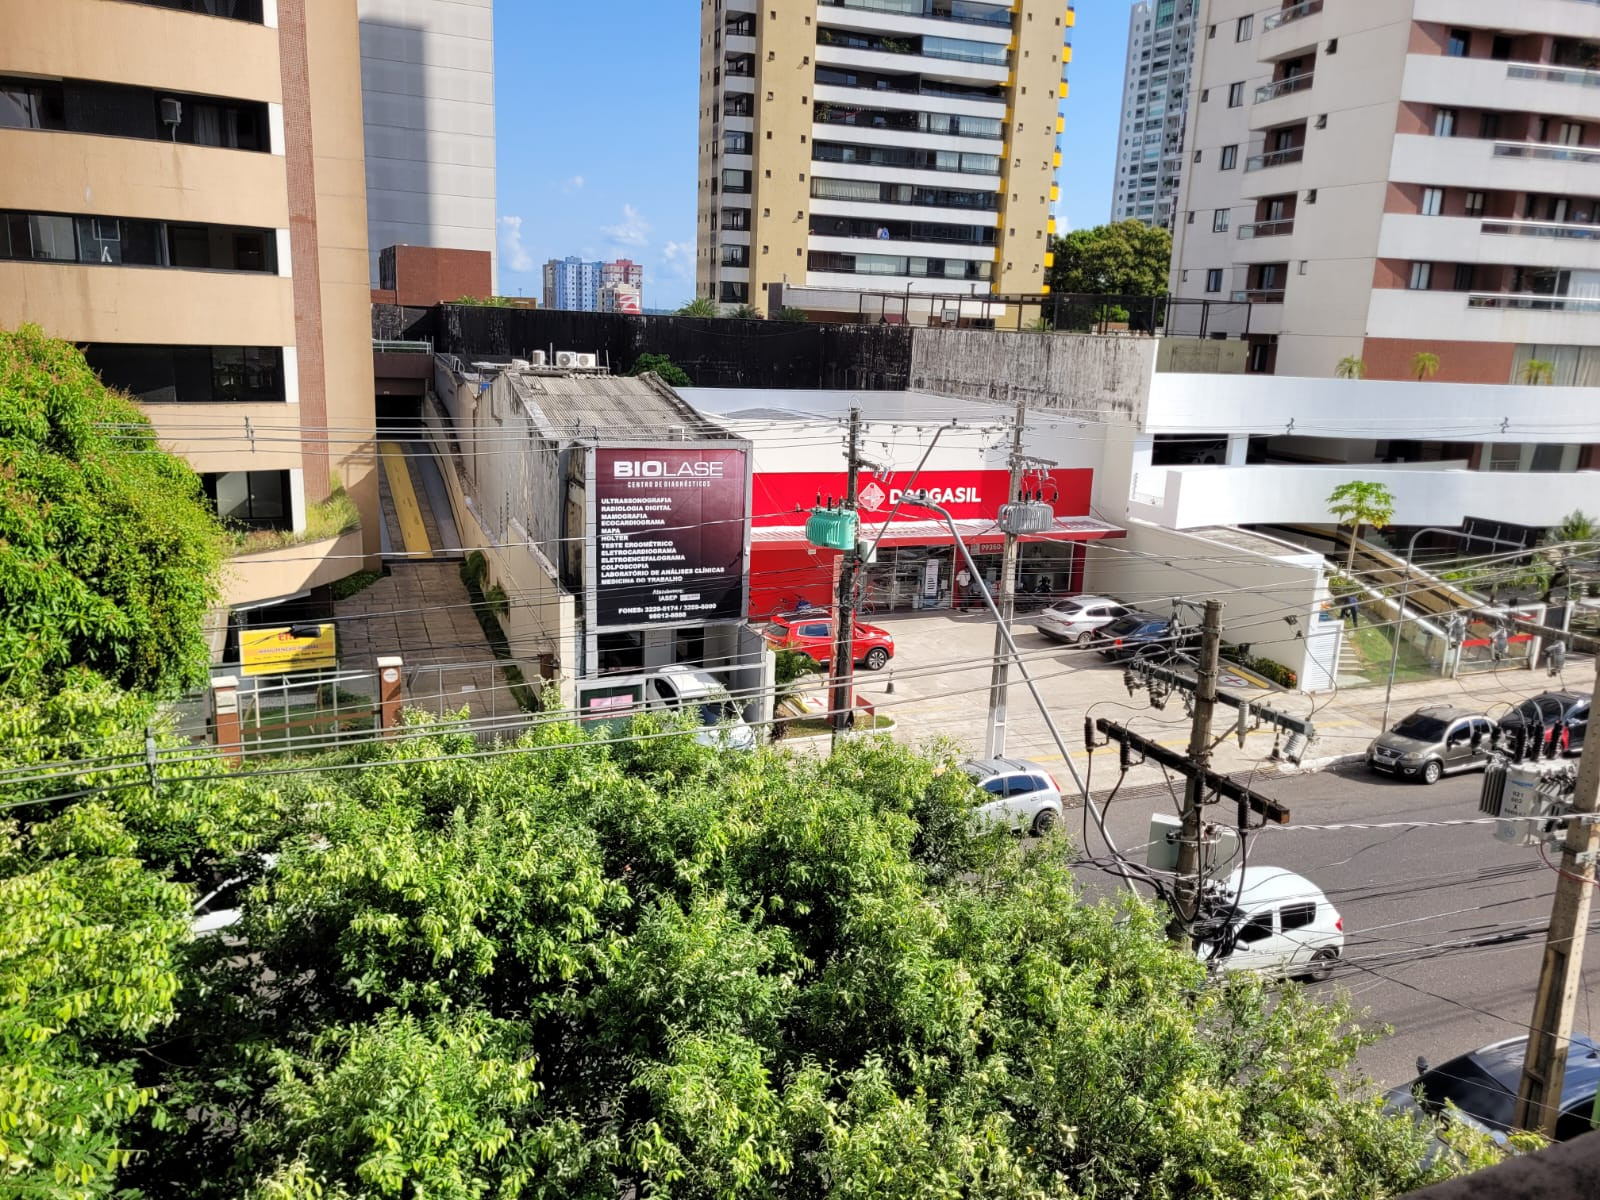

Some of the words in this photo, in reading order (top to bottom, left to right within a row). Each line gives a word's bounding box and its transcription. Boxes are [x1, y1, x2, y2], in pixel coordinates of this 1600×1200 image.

[613, 460, 723, 477] BIOLASE
[601, 497, 672, 505] ULTRASSONOGRAFIA
[601, 519, 665, 527] ECOCARDIOGRAMA
[601, 547, 677, 556] ELETROCARDIOGRAMA
[601, 554, 686, 564] ELETROENCEFALOGRAMA
[601, 563, 649, 571] COLPOSCOPIA
[601, 570, 649, 578] LABORATÓRIO
[661, 567, 694, 576] ANÁLISES
[694, 566, 725, 574] CLÍNICAS
[601, 577, 635, 585] MEDICINA
[647, 575, 683, 583] TRABALHO
[618, 607, 644, 615] FONES:
